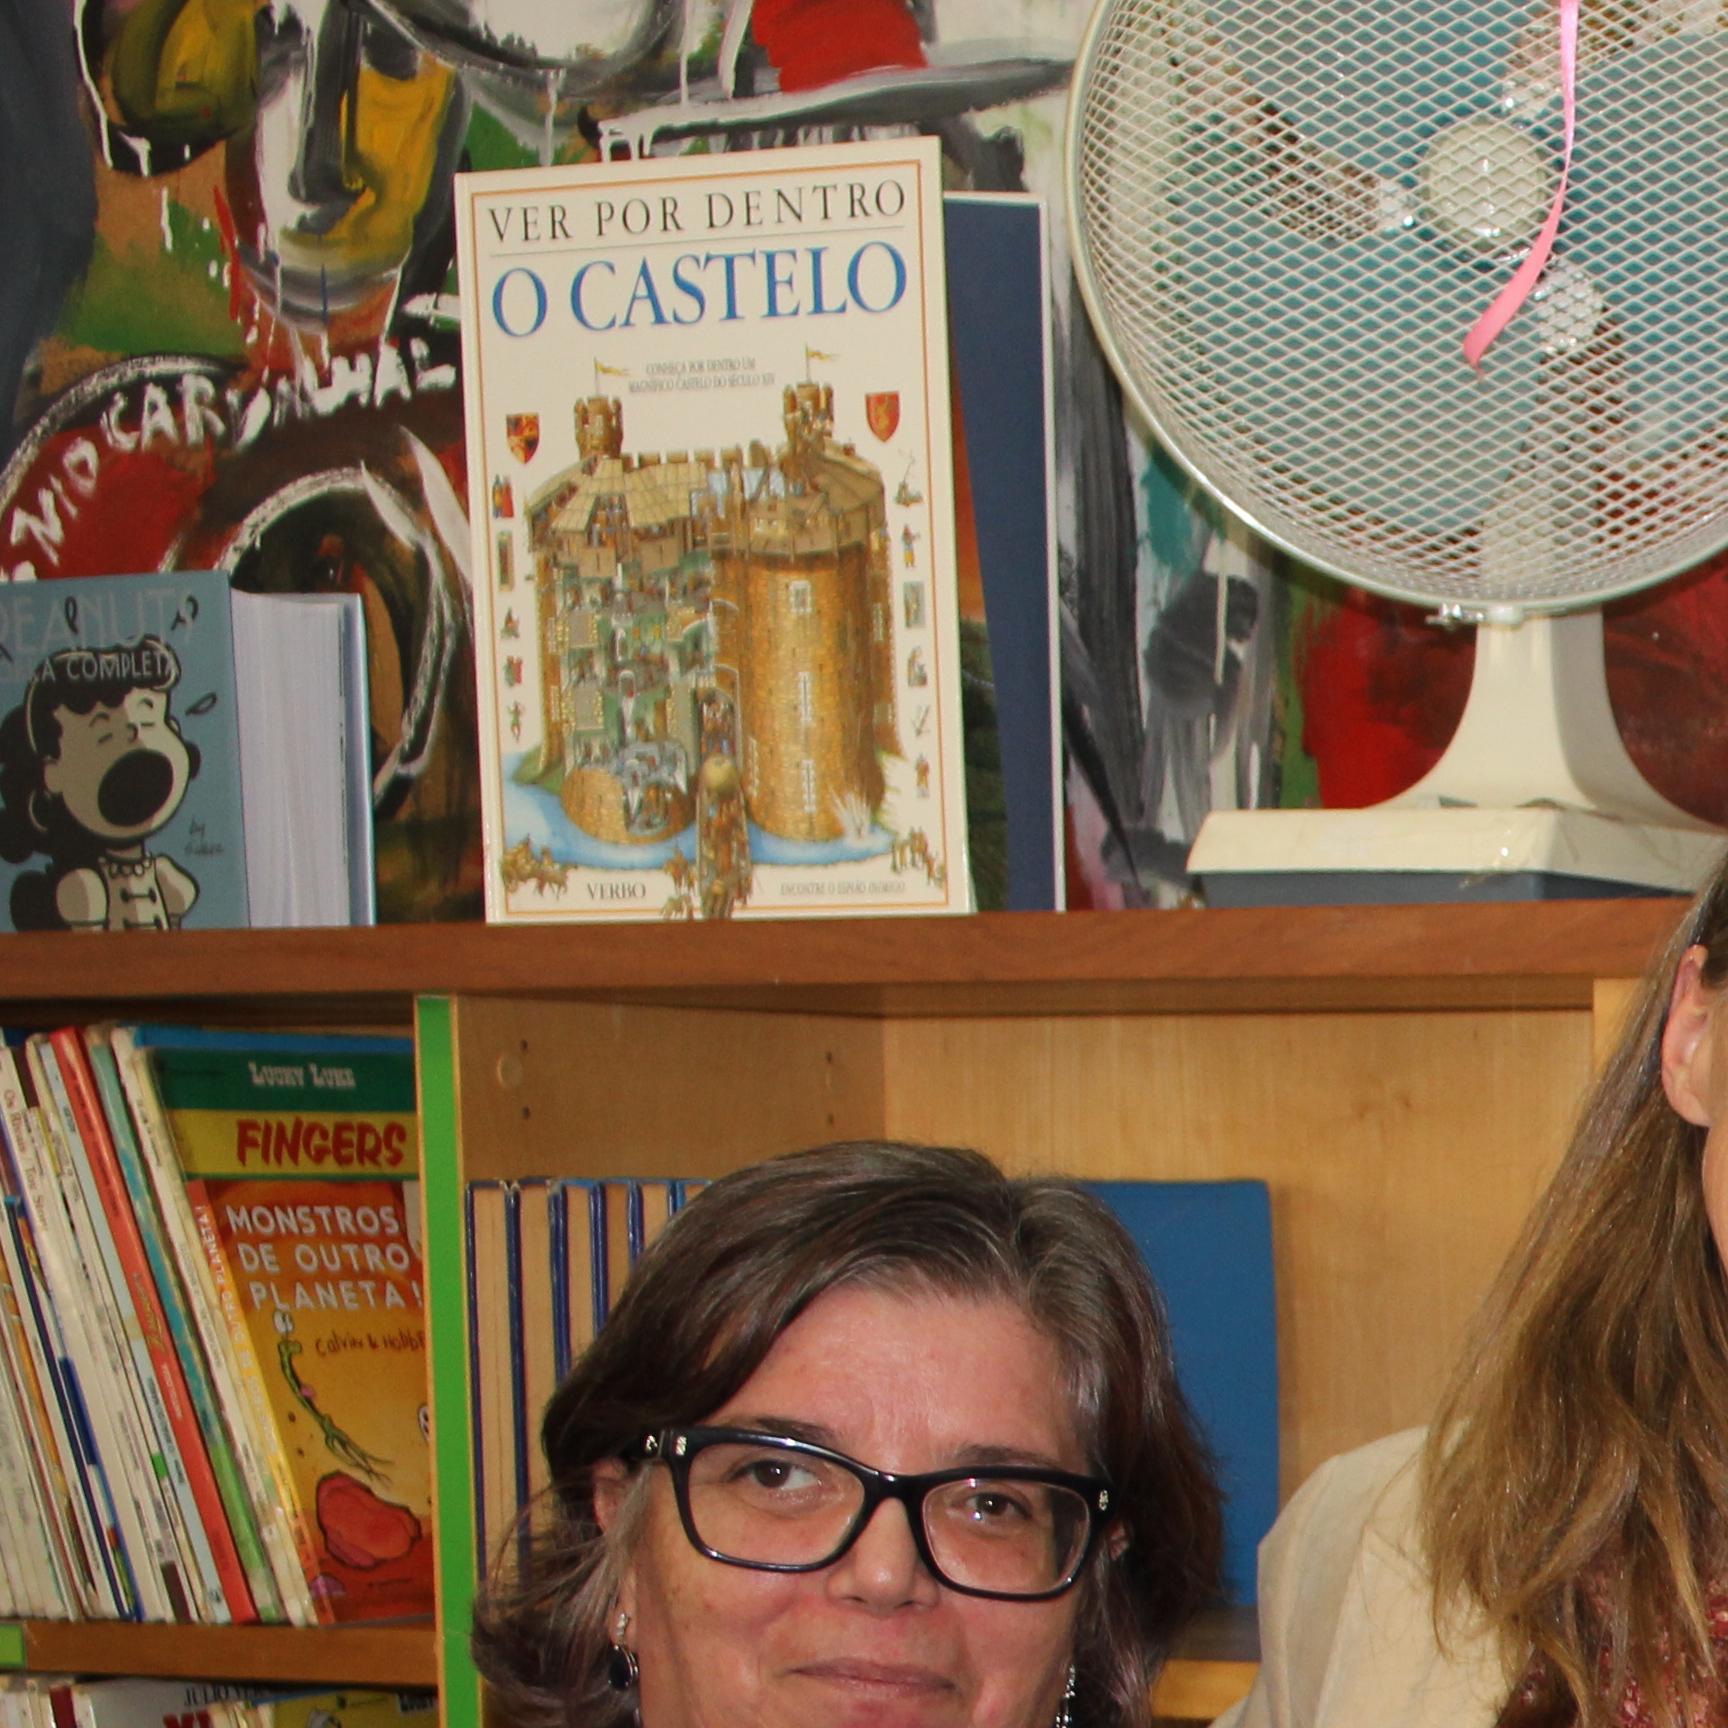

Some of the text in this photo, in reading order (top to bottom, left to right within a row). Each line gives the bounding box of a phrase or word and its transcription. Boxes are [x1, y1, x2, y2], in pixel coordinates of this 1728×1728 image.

[489, 179, 905, 243] VER POR DENTRO
[492, 240, 907, 337] O CASTELO
[706, 358, 741, 372] DENTRO
[675, 374, 712, 391] CASTELO
[586, 881, 646, 900] VERBO
[236, 1115, 408, 1168] FINGERS
[225, 1204, 399, 1236] MONSTROS
[237, 1242, 411, 1274] DE OUTRO
